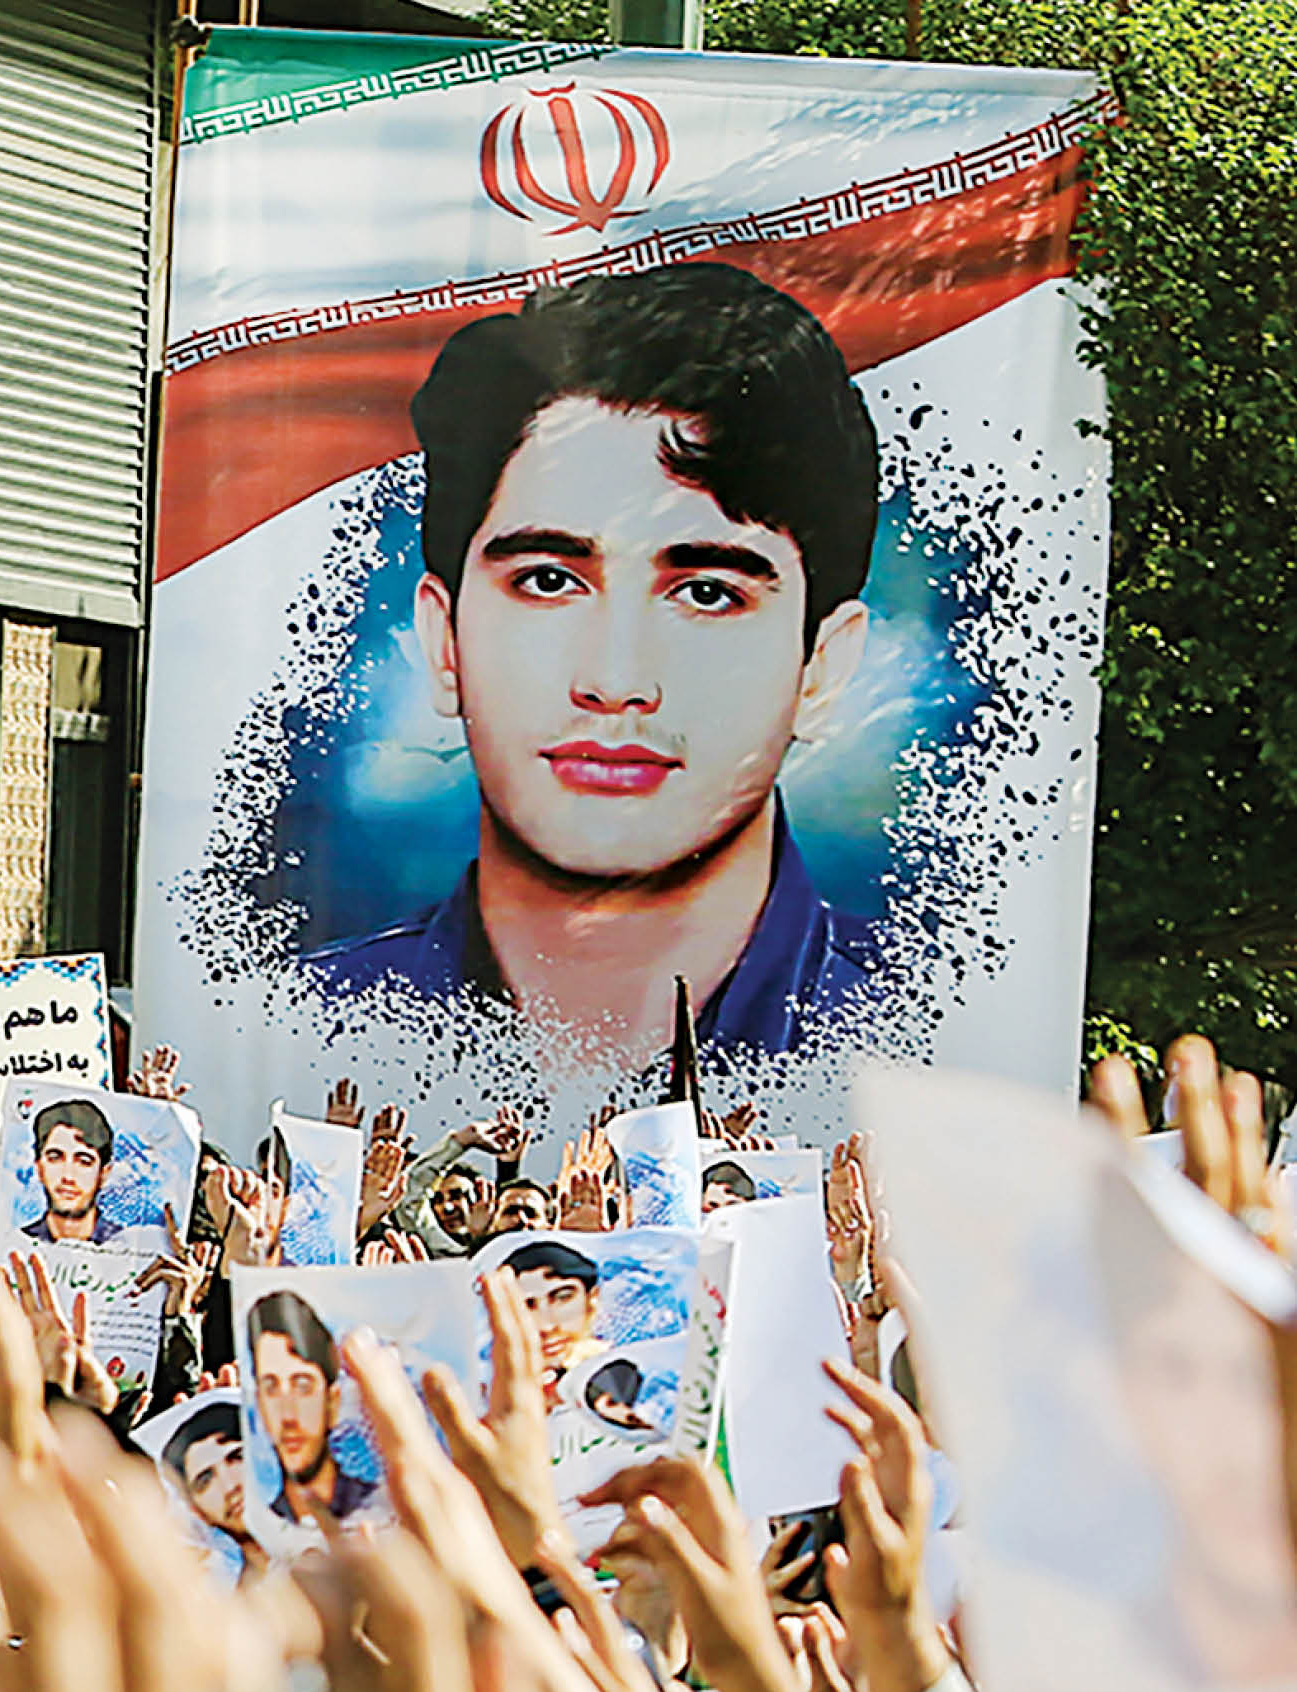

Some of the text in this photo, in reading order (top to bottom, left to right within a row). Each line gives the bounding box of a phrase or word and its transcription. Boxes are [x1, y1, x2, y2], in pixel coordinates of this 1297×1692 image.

[5, 1008, 45, 1040] هم
[51, 1001, 78, 1024] ما
[67, 1055, 88, 1077] به
